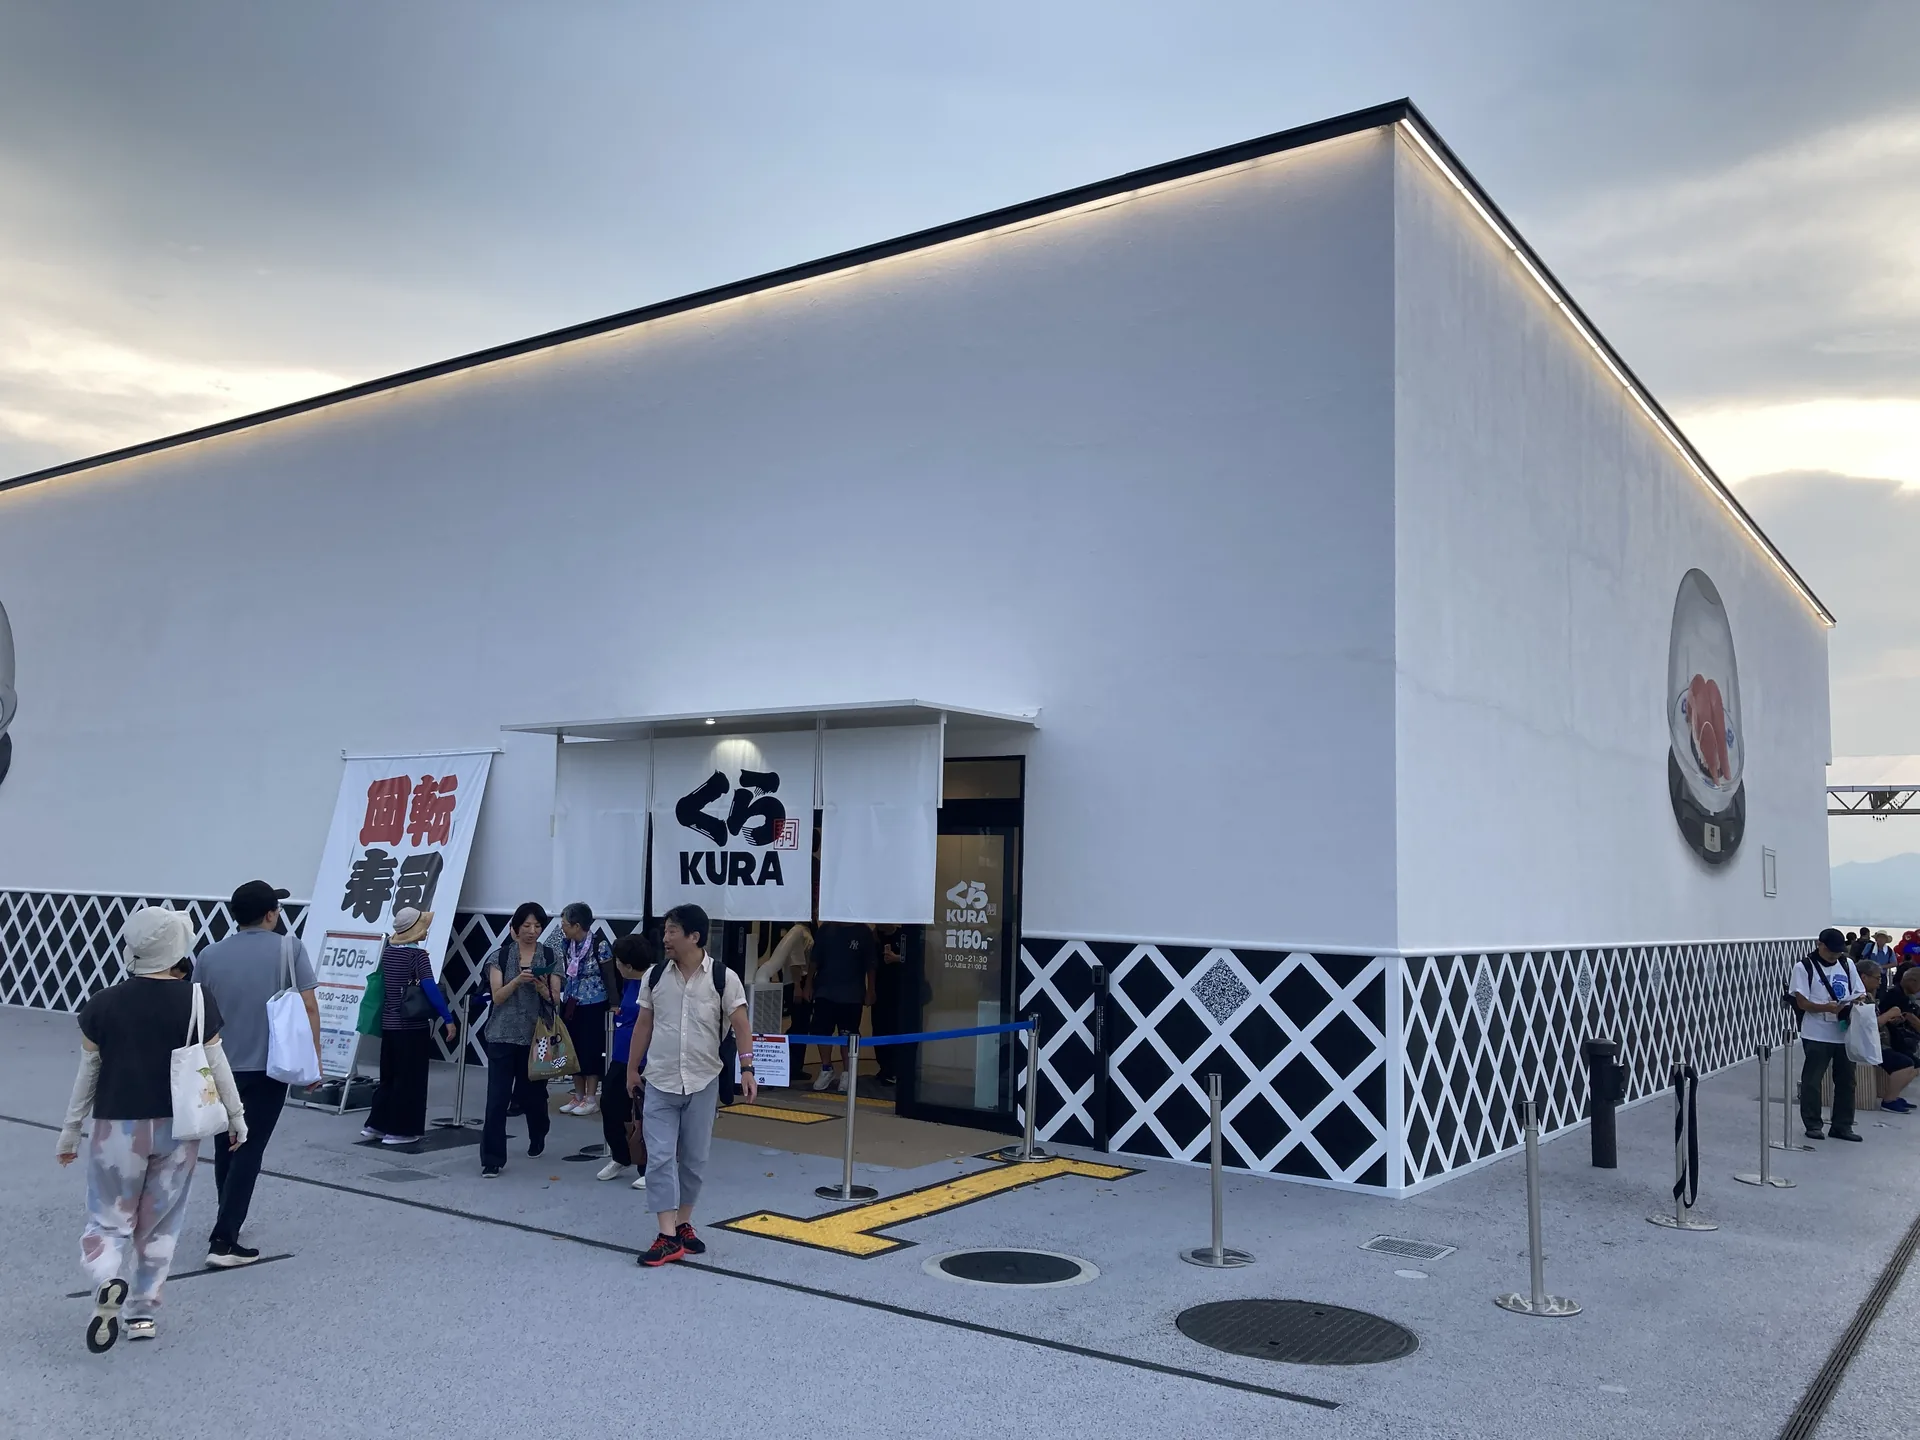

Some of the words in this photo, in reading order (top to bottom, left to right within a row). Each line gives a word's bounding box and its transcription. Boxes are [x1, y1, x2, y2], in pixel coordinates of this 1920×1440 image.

[359, 774, 458, 847] 回転
[675, 769, 786, 847] くら
[341, 848, 444, 923] 寿司
[679, 851, 785, 886] KURA
[946, 880, 988, 909] くら
[946, 909, 988, 924] KURA
